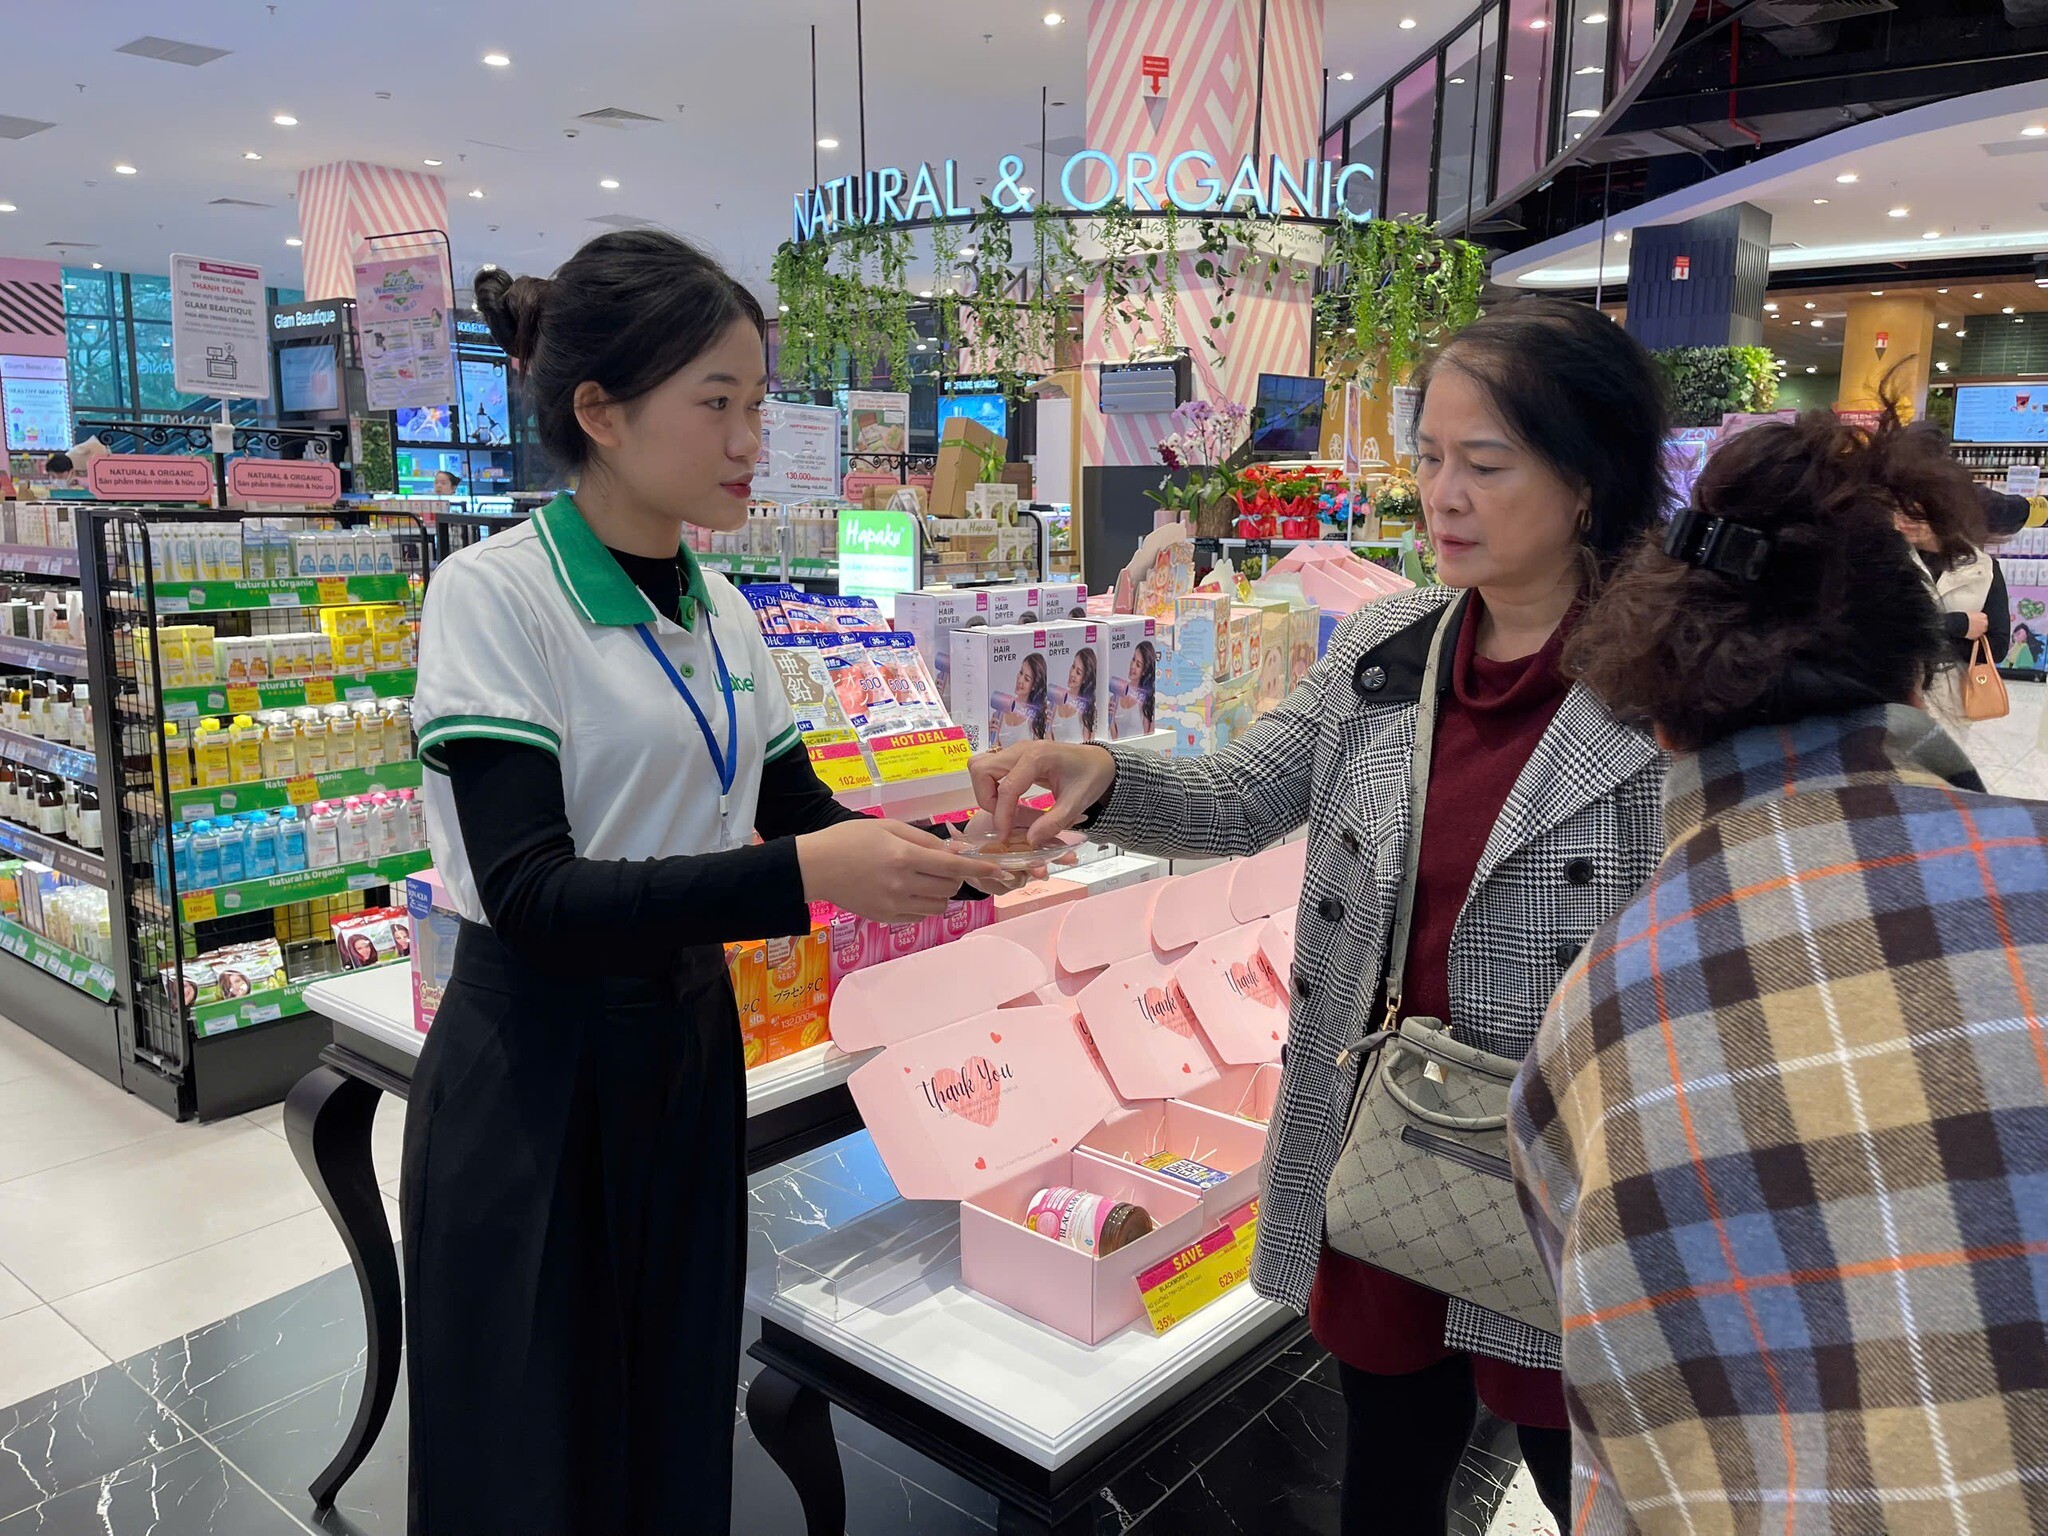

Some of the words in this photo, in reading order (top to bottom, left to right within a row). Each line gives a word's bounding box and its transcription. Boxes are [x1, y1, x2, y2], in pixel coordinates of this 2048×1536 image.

[793, 158, 973, 245] NATURAL
[991, 153, 1036, 214] &
[1060, 149, 1375, 224] ORGANIC
[184, 300, 208, 310] GLAM
[209, 302, 253, 316] BEAUTIQUE
[274, 310, 296, 329] Glam
[296, 309, 336, 328] Beautique
[248, 472, 282, 480] NATURAL
[846, 518, 903, 550] Hapaku
[235, 580, 270, 590] Natural
[270, 580, 278, 588] &
[280, 578, 314, 589] Organic
[766, 595, 778, 606] DH
[780, 590, 800, 602] DHC
[828, 598, 849, 606] DHC
[1046, 600, 1060, 608] HAIR
[938, 608, 954, 616] HAIR
[994, 611, 1014, 620] DRYER
[1046, 606, 1064, 616] DRYER
[938, 616, 960, 624] DRYER
[816, 638, 830, 649] HC
[1049, 640, 1064, 648] HAIR
[1112, 634, 1126, 642] HAIR
[994, 646, 1011, 654] HAIR
[1049, 647, 1070, 656] DRYER
[1112, 641, 1132, 650] DRYER
[993, 654, 1017, 663] DRYER
[290, 680, 298, 690] &
[860, 676, 882, 692] 500
[888, 679, 910, 692] 500
[891, 732, 918, 748] HOT
[918, 730, 948, 745] DEAL
[265, 778, 287, 790] Natu
[314, 772, 342, 784] rganic
[268, 875, 300, 888] Natural
[302, 874, 310, 884] &
[312, 866, 346, 880] Organic
[284, 983, 306, 996] Natu
[915, 1066, 975, 1112] Thank
[977, 1058, 1014, 1091] You
[1166, 1161, 1193, 1172] DHA
[1178, 1166, 1206, 1178] EPA
[1172, 1244, 1204, 1272] SAVE
[1160, 1272, 1189, 1292] BLACKMORES
[1156, 1314, 1176, 1332] -35%
